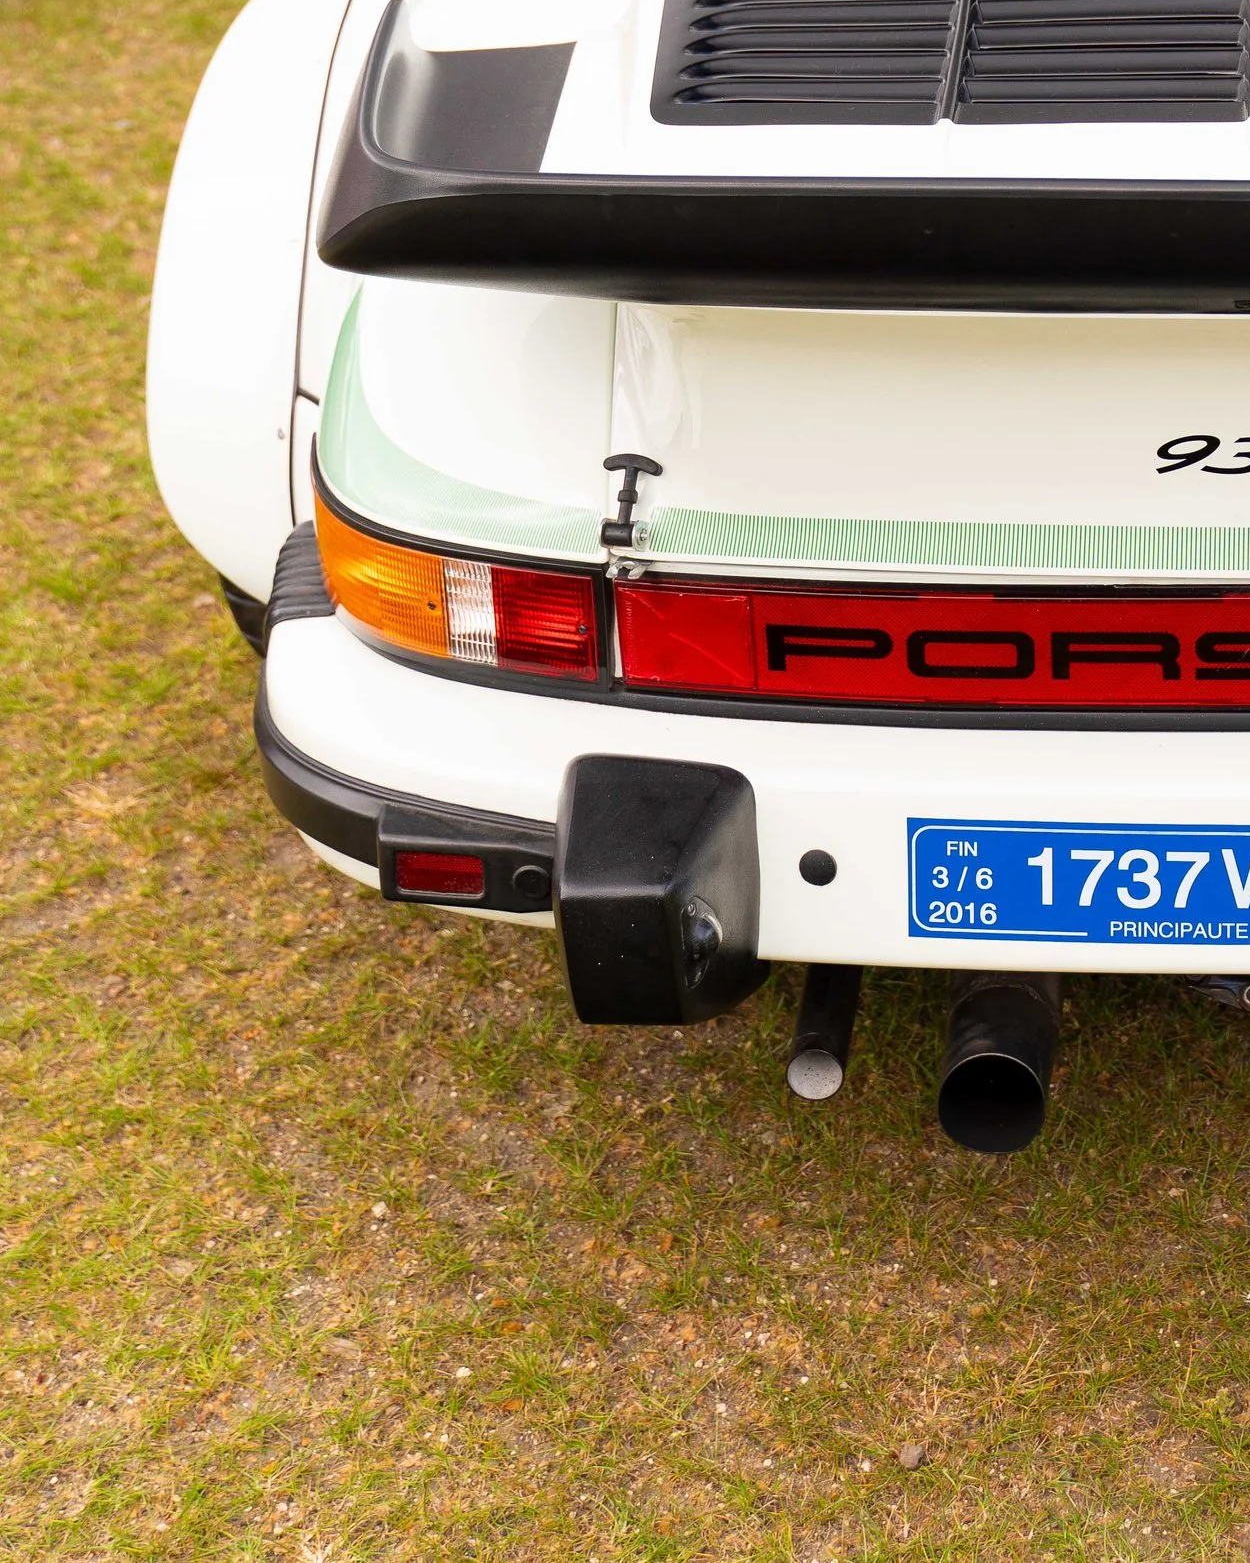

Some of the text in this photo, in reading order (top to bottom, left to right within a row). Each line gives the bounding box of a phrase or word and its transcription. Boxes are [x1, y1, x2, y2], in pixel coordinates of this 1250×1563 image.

[946, 840, 978, 857] FIN
[928, 901, 997, 925] 2016
[1110, 921, 1249, 939] PRINCIPAUTE
